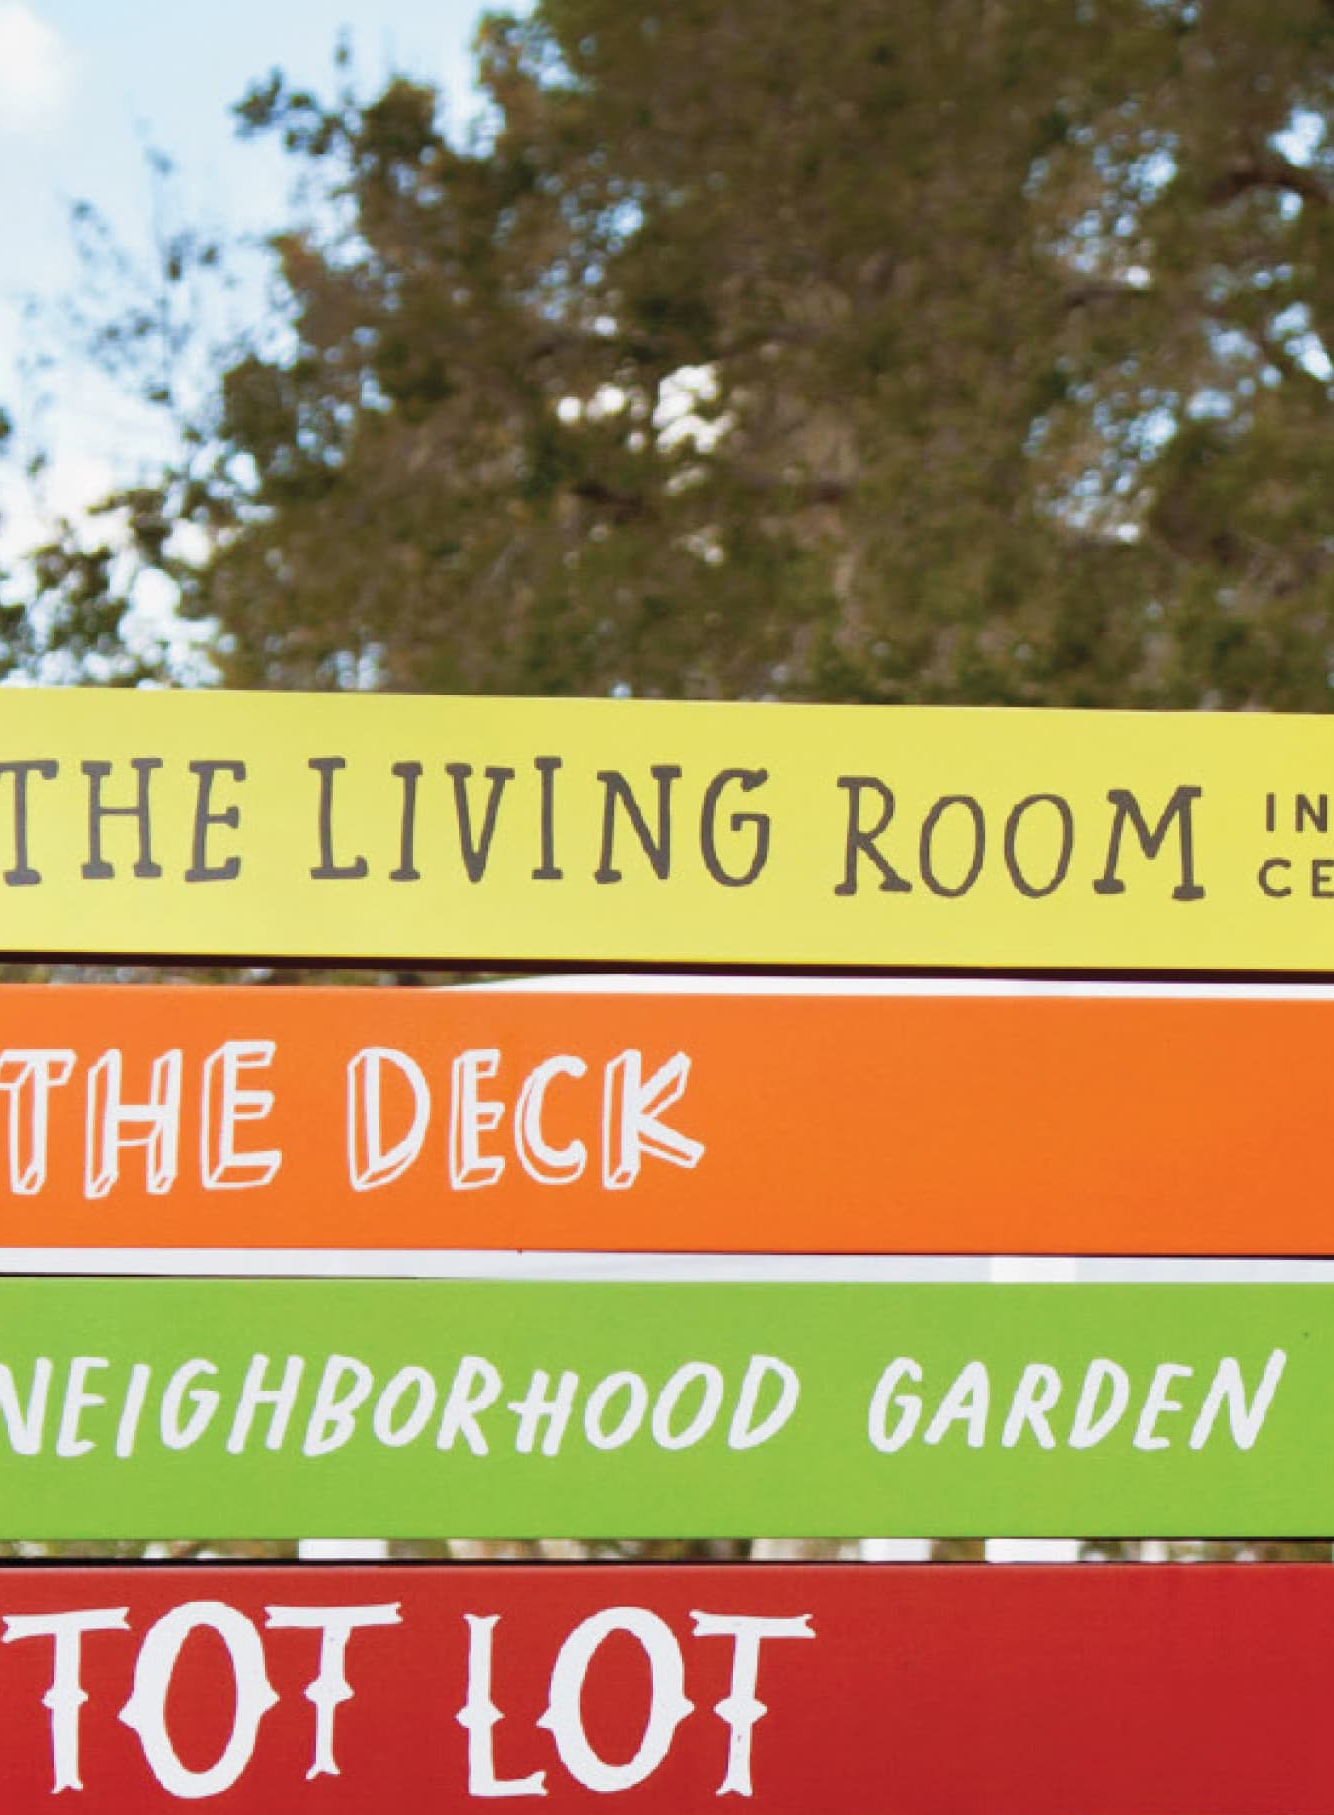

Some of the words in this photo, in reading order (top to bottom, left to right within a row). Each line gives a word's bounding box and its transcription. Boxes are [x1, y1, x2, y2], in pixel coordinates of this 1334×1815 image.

[308, 756, 770, 887] LIVING
[835, 777, 1205, 901] ROOM
[347, 1047, 704, 1191] DECK
[868, 1349, 1287, 1454] GARDEN
[2, 1601, 401, 1798] TOT
[456, 1607, 815, 1796] LOT
